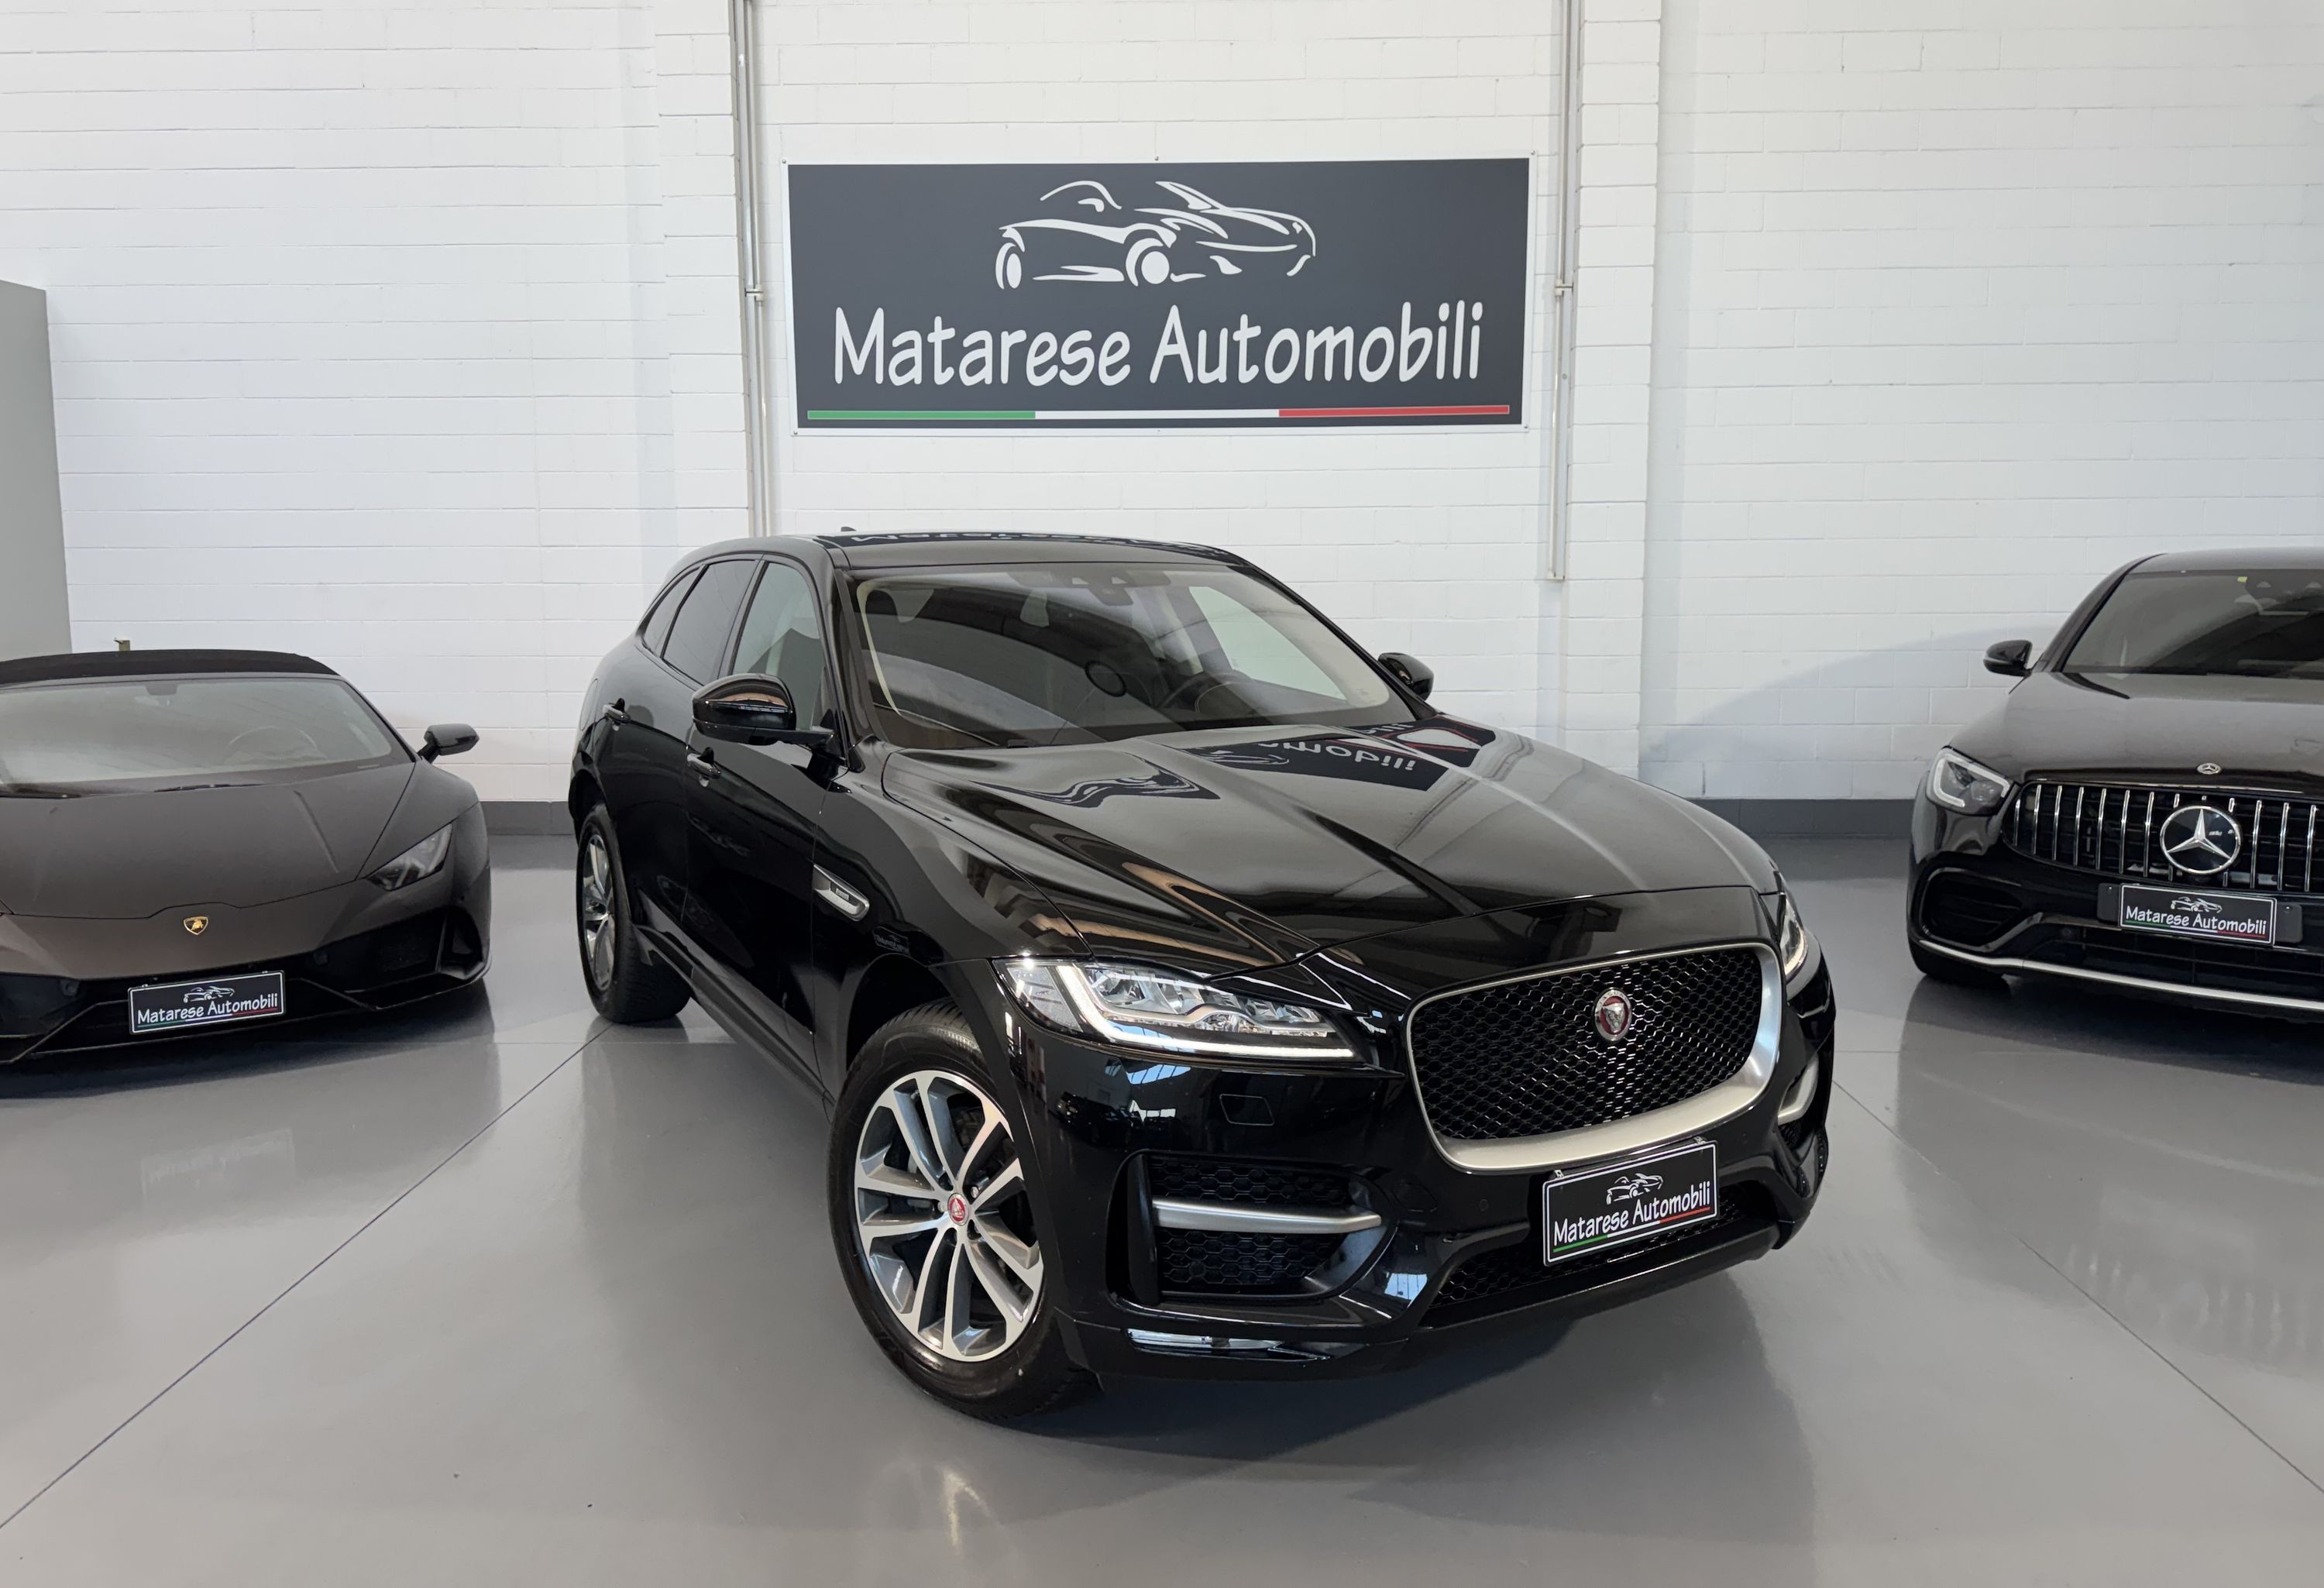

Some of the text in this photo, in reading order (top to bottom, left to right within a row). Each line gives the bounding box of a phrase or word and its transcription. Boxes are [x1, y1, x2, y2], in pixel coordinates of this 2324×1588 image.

[834, 299, 1483, 387] Matarese Automobili
[2126, 905, 2267, 935] Matarese Automobili
[137, 992, 278, 1025] Matarese Automobili
[1553, 1181, 1710, 1246] Matarese Automobili
